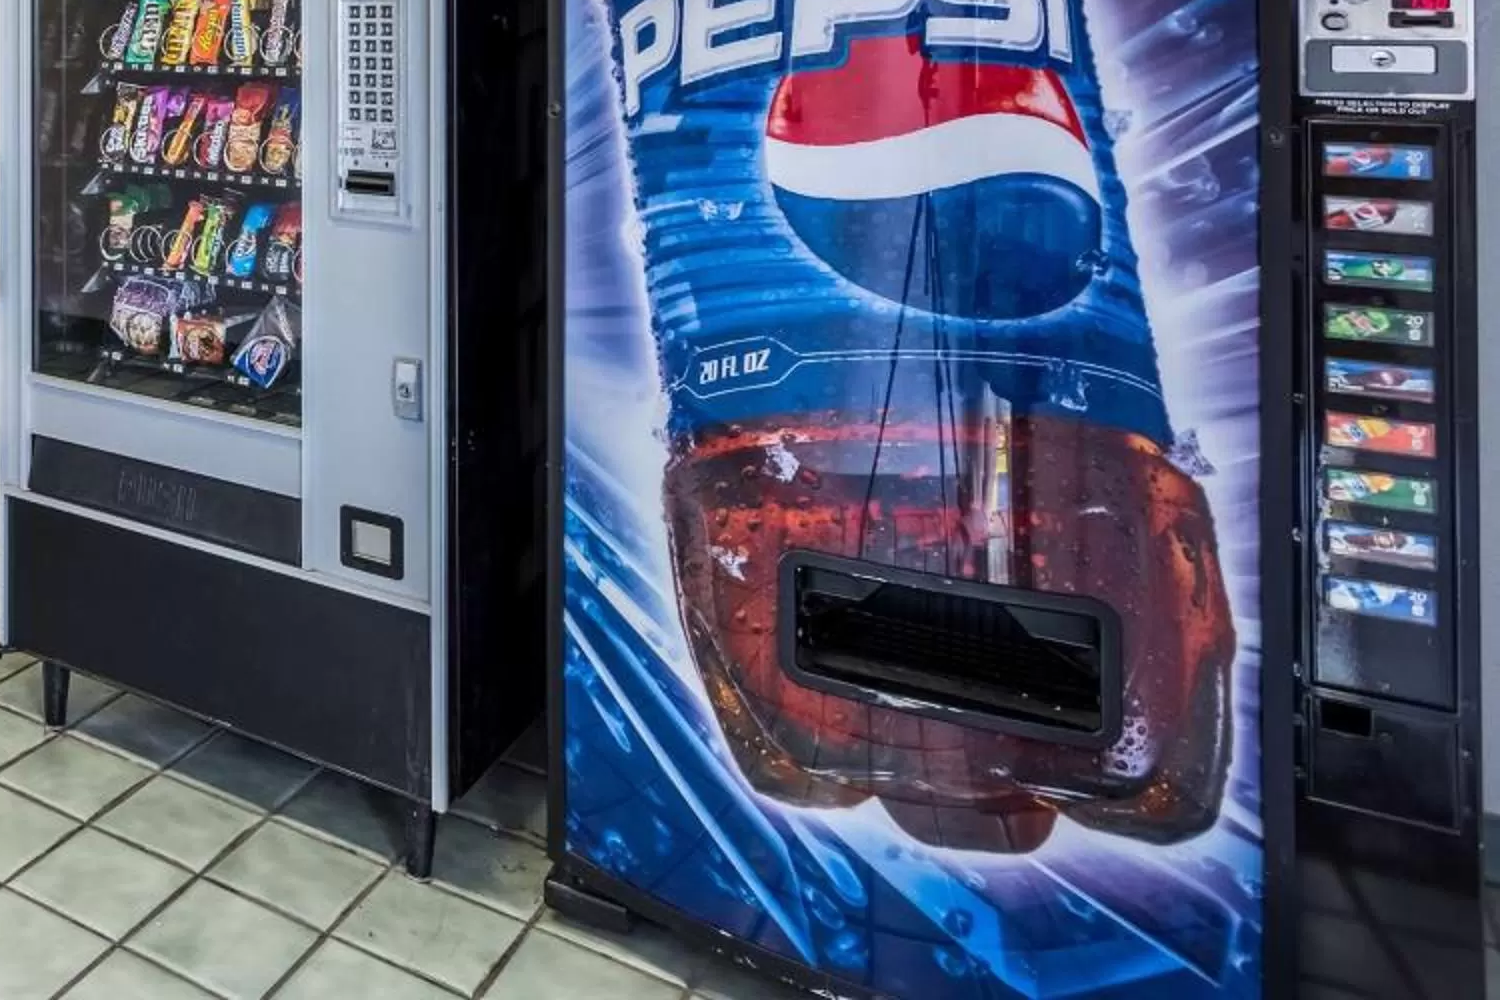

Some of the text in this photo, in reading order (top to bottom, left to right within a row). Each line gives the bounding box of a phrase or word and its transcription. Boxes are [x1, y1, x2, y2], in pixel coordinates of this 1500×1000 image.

[700, 347, 771, 385] 20 FL OZ
